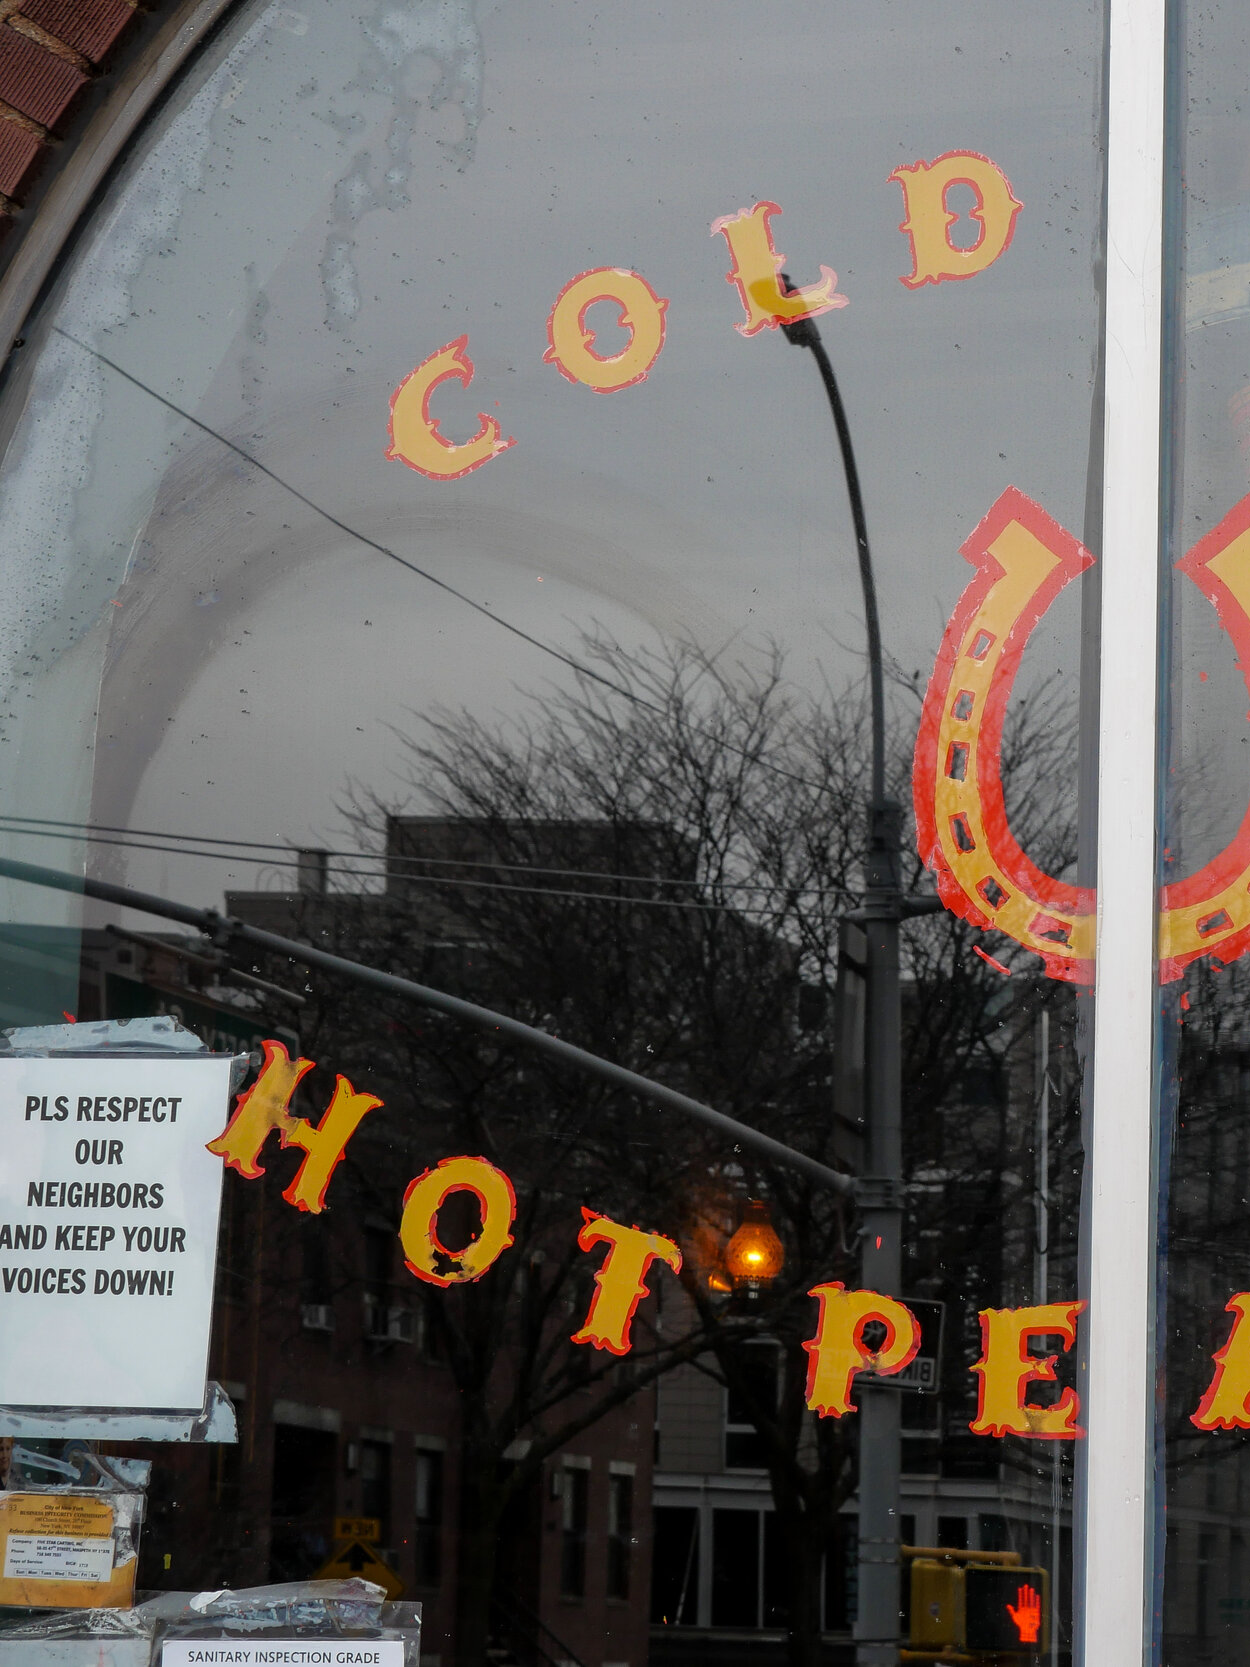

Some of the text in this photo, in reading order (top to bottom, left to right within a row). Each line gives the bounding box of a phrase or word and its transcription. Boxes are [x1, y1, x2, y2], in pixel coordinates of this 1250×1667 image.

[389, 150, 1022, 480] COLD
[25, 1095, 182, 1123] PLS RESPECT
[75, 1138, 124, 1165] OUR
[27, 1181, 164, 1209] NEIGHBORS
[206, 1040, 682, 1356] HOT
[0, 1224, 186, 1253] AND KEEP YOUR
[2, 1267, 174, 1296] VOICES DOWN!
[188, 1650, 380, 1665] SANITARY INSPECTION GRADE
